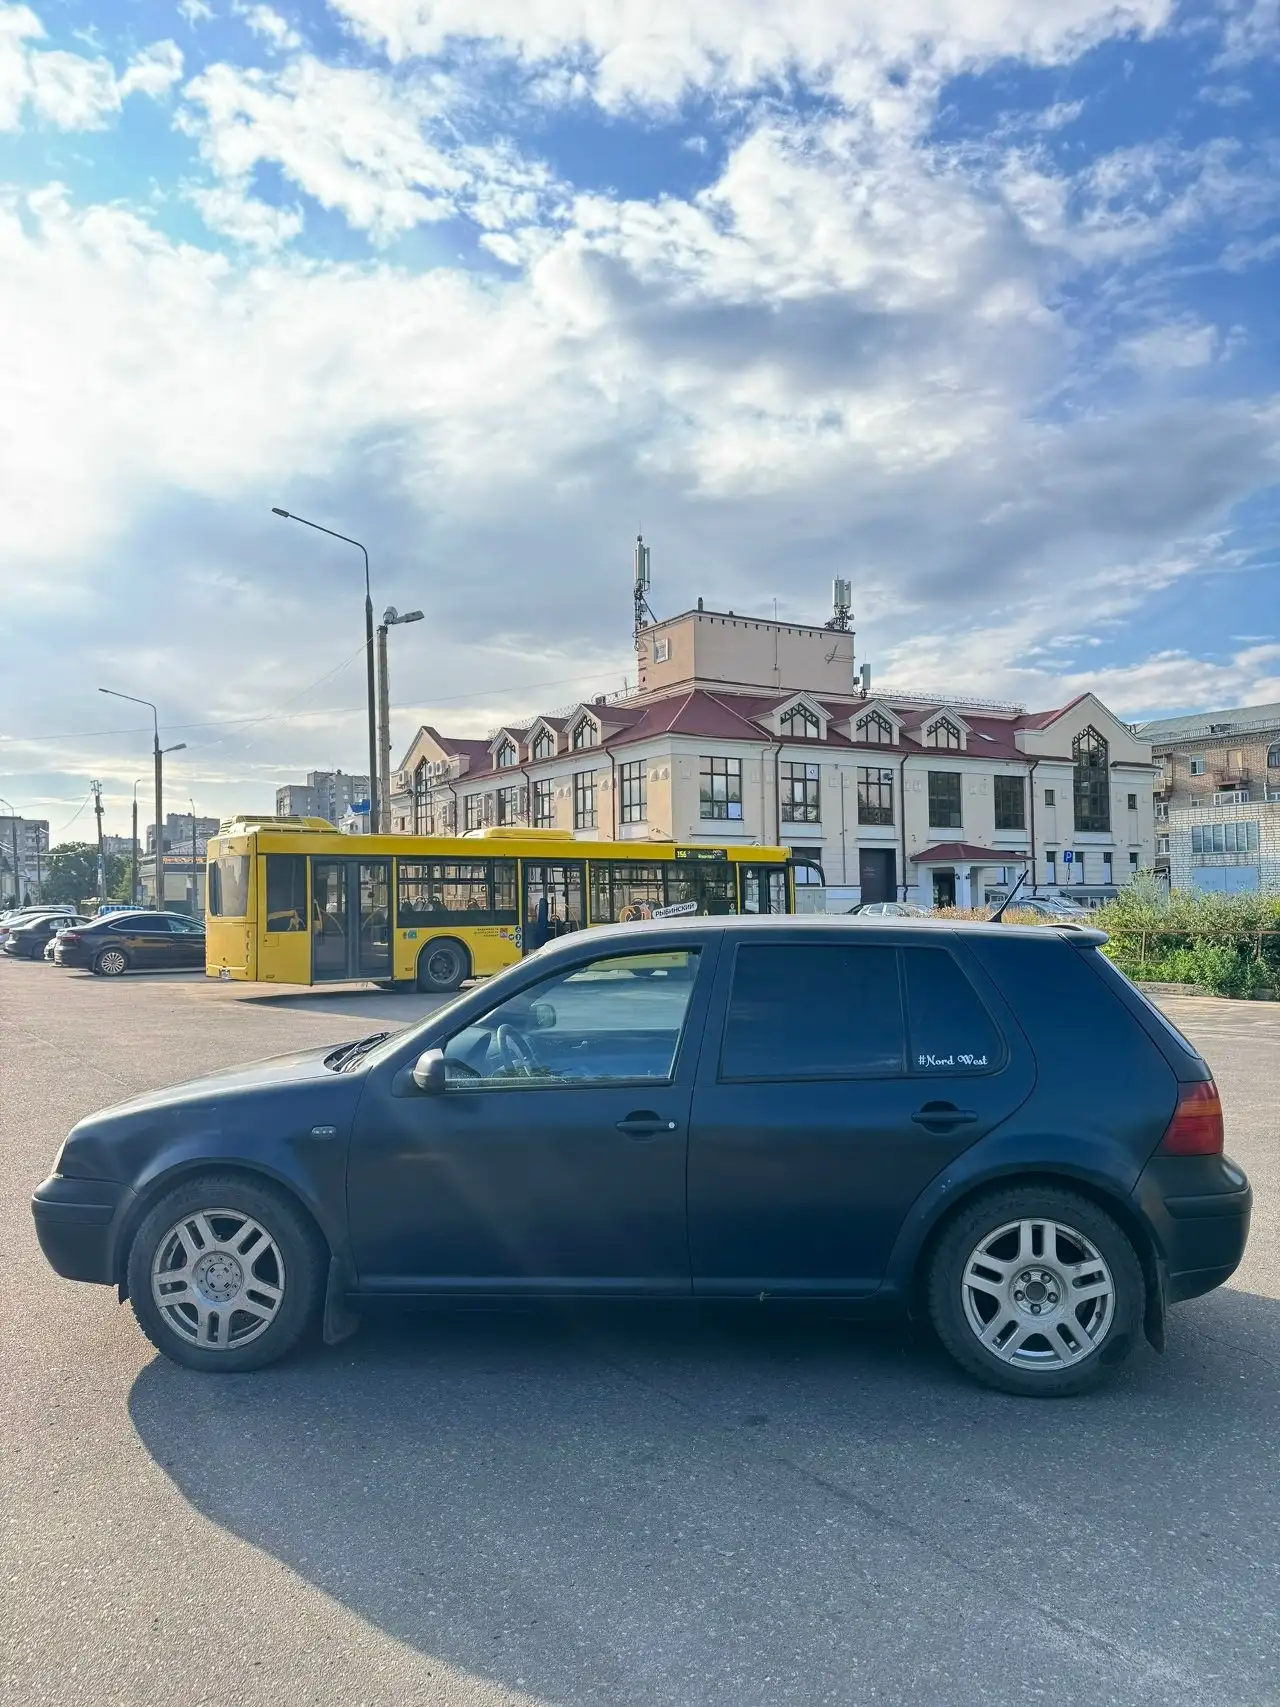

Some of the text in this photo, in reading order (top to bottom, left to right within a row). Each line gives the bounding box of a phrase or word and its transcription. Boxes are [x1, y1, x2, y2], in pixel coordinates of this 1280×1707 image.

[655, 903, 695, 917] РЫБИНСКИЙ
[918, 1054, 988, 1067] #Nord West
